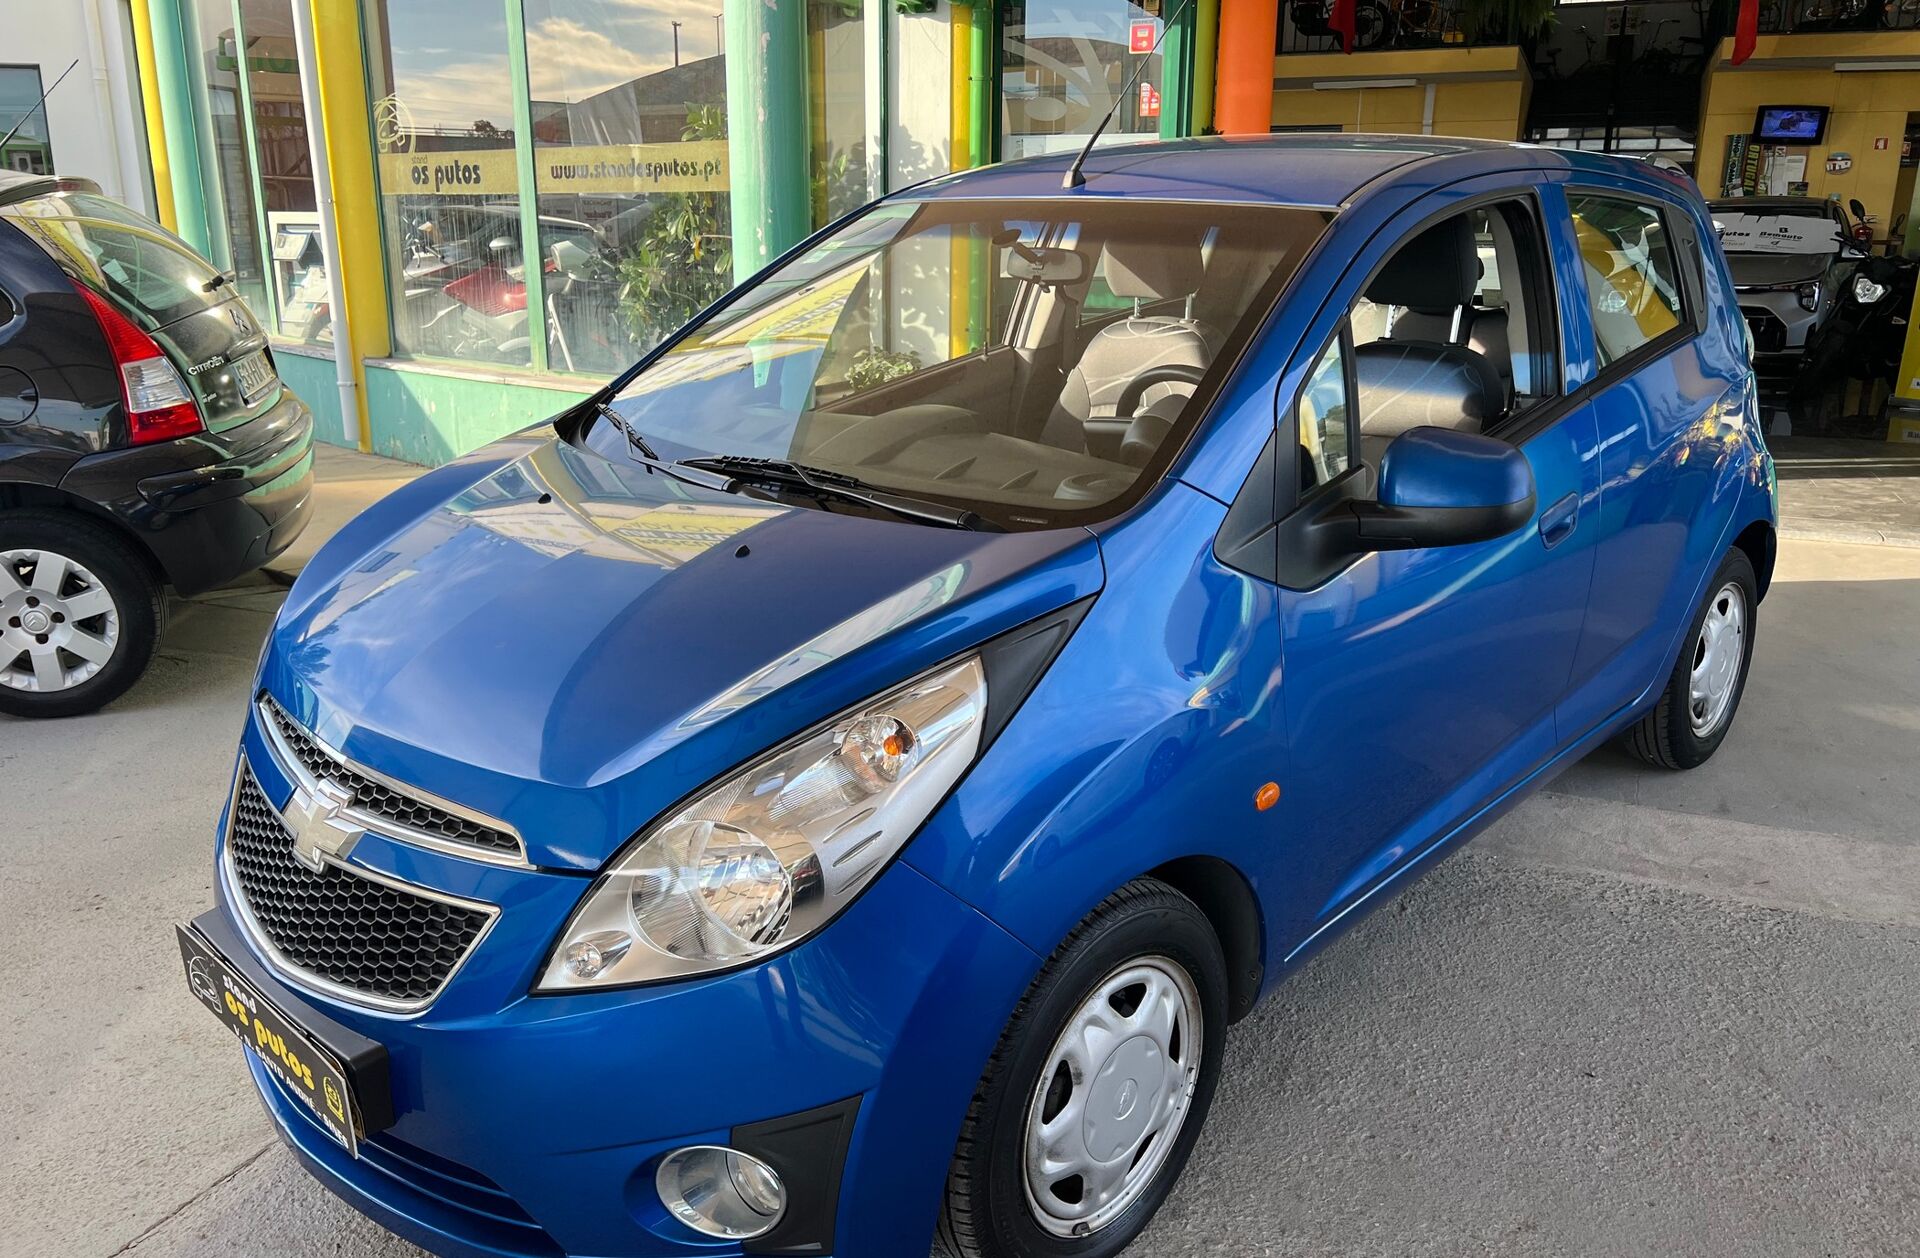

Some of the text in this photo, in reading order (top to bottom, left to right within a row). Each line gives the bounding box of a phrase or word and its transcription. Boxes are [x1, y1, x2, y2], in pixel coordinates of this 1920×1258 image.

[411, 159, 481, 192] os putos
[1744, 145, 1761, 193] ORTUGAL
[222, 974, 257, 1014] stand
[224, 991, 315, 1090] os putos
[255, 1045, 284, 1079] SANTO
[322, 1113, 349, 1149] SINES
